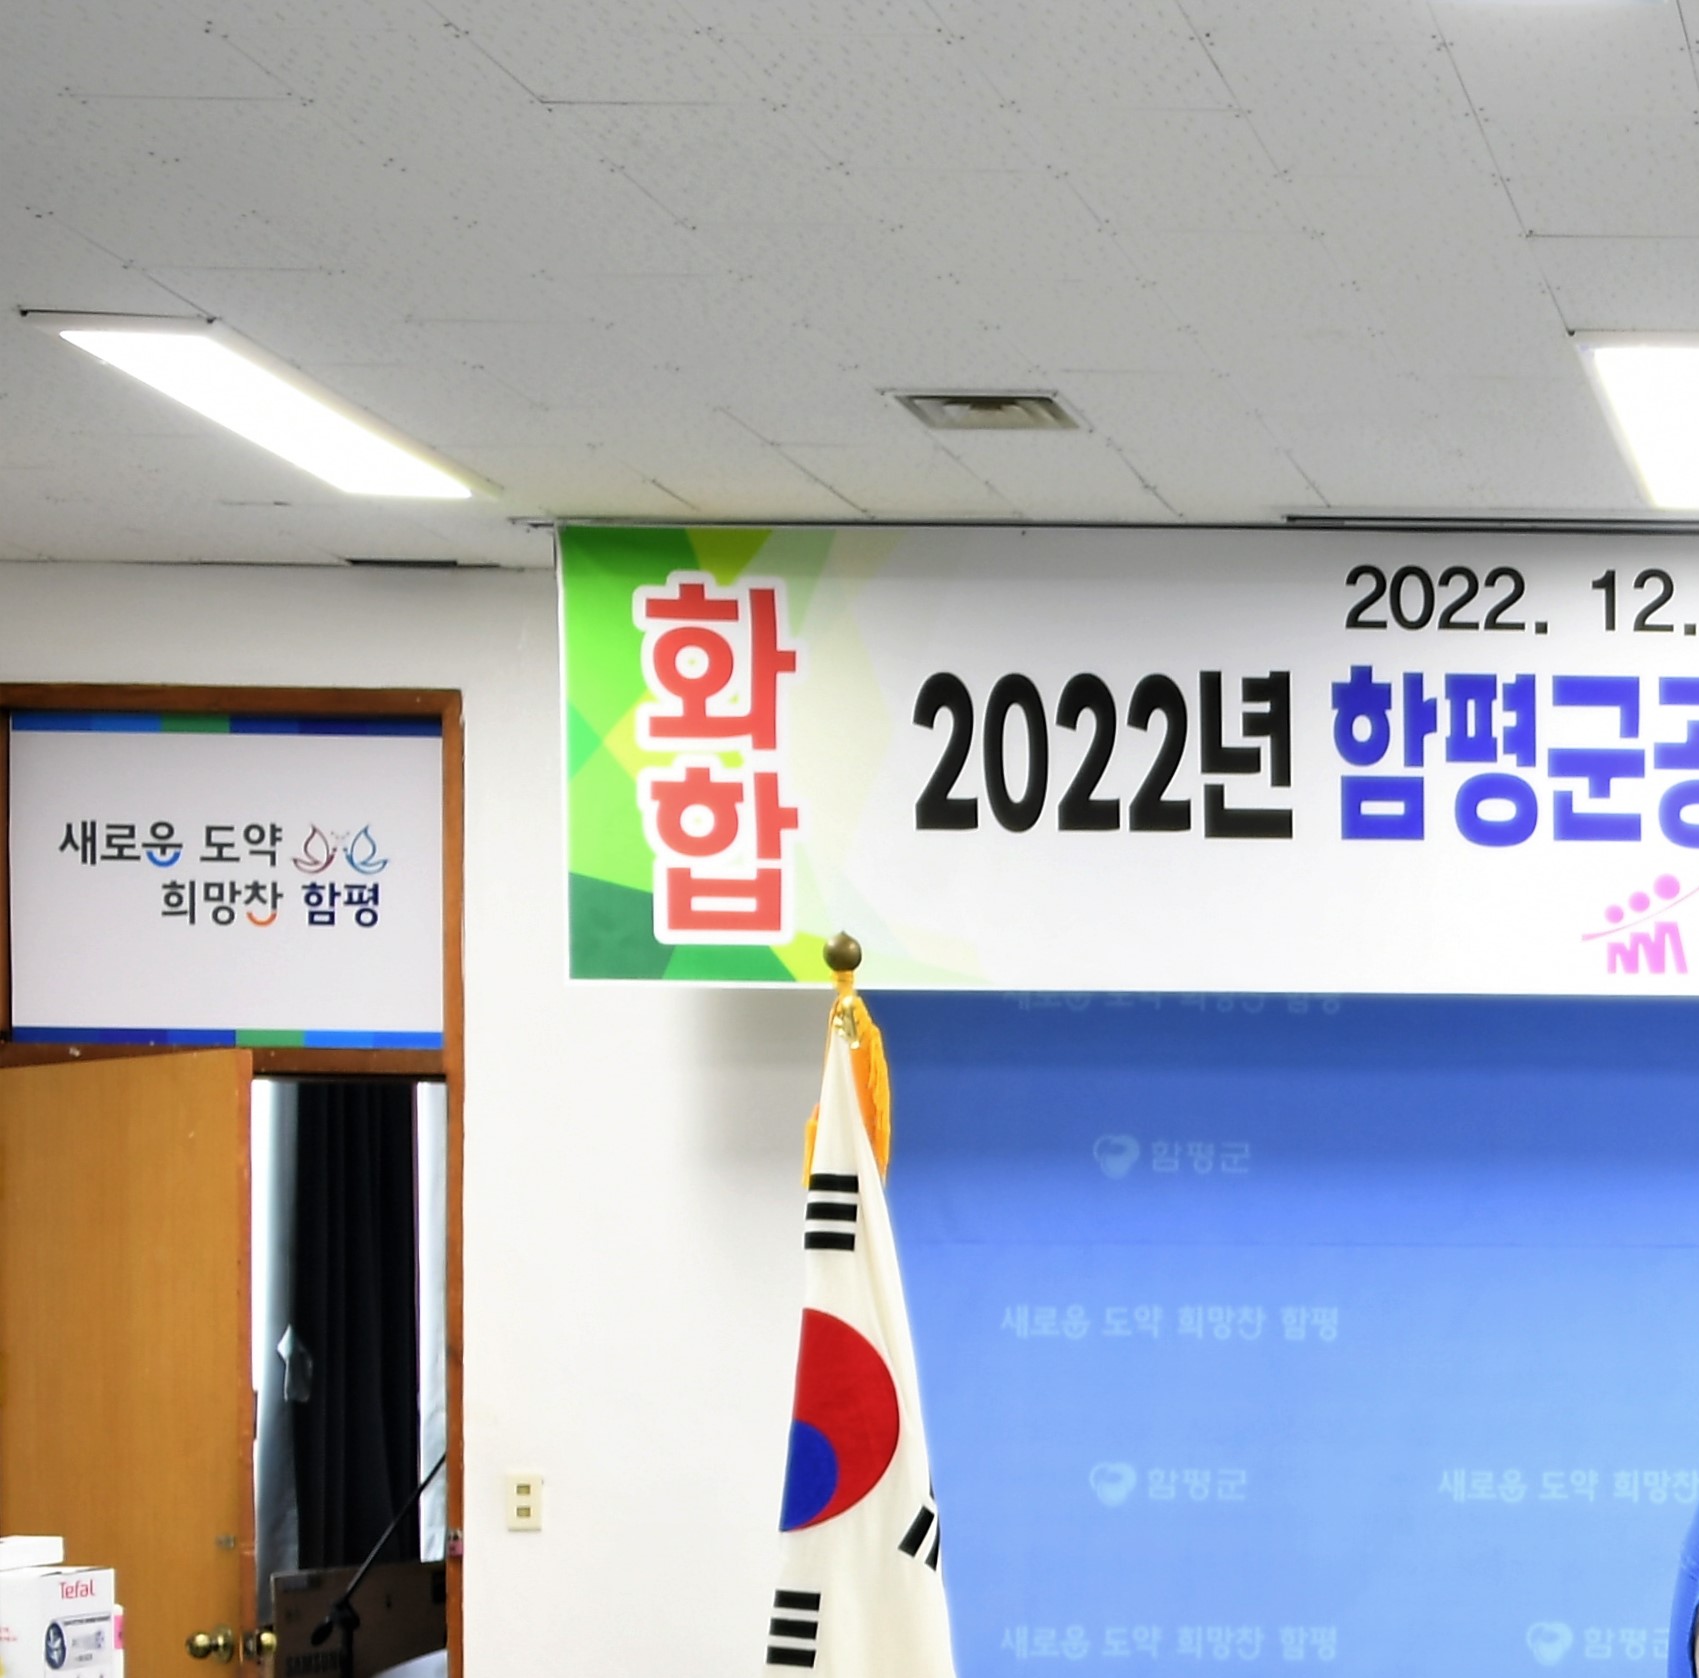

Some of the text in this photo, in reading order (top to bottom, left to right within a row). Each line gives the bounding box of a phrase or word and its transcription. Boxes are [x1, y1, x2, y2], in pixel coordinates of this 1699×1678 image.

[1343, 565, 1548, 636] 2022.
[1594, 569, 1699, 637] 12.
[644, 582, 798, 932] 화합
[911, 668, 1294, 840] 2022년
[58, 820, 284, 869] 새로운 도약
[160, 879, 381, 929] 희망찬 함평
[1150, 1140, 1251, 1175] 함평군
[1000, 1303, 1091, 1341] 새로운
[1102, 1303, 1164, 1339] 도약
[1279, 1304, 1339, 1343] 함평
[1146, 1466, 1247, 1503] 함평군
[1437, 1468, 1528, 1504] 새로운
[1537, 1468, 1600, 1503] 도약
[59, 1579, 95, 1599] Tefal
[1000, 1624, 1091, 1661] 새로운
[1101, 1624, 1163, 1660] 도약
[1279, 1624, 1338, 1663] 함평
